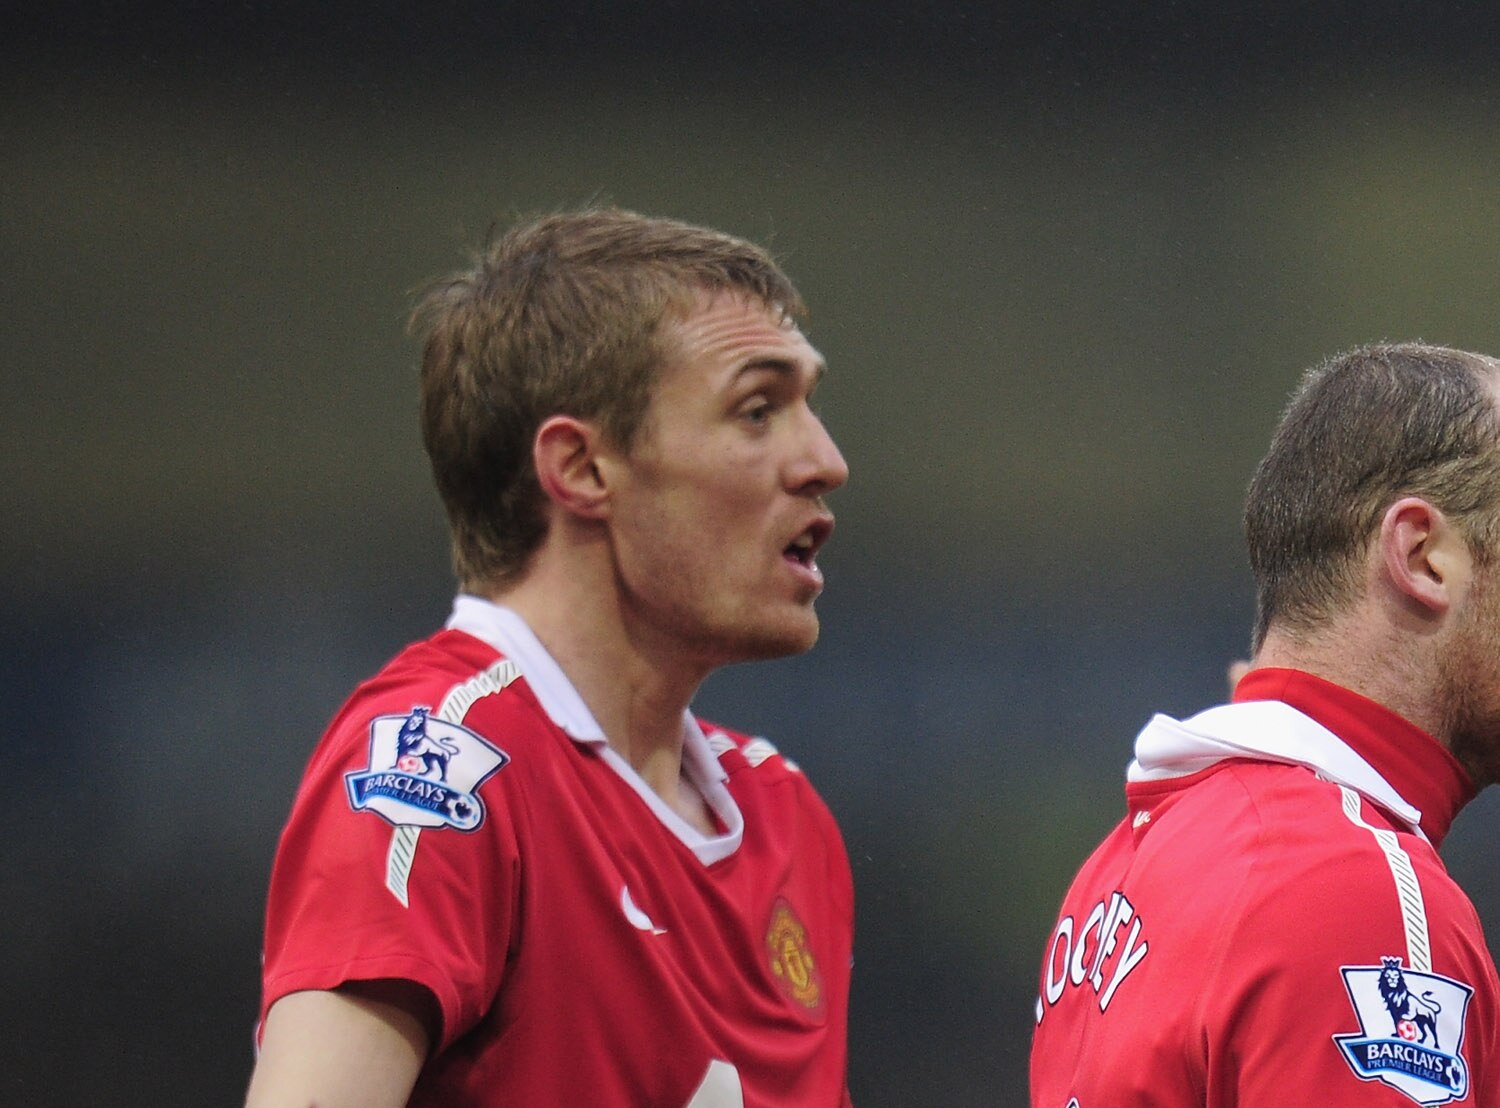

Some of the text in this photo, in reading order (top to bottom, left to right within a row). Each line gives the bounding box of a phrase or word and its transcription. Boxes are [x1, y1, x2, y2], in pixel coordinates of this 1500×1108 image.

[365, 774, 447, 803] BARCLAYS
[1367, 1042, 1444, 1073] BARCLAYS
[1367, 1058, 1443, 1081] PREMIER LEAGUE
